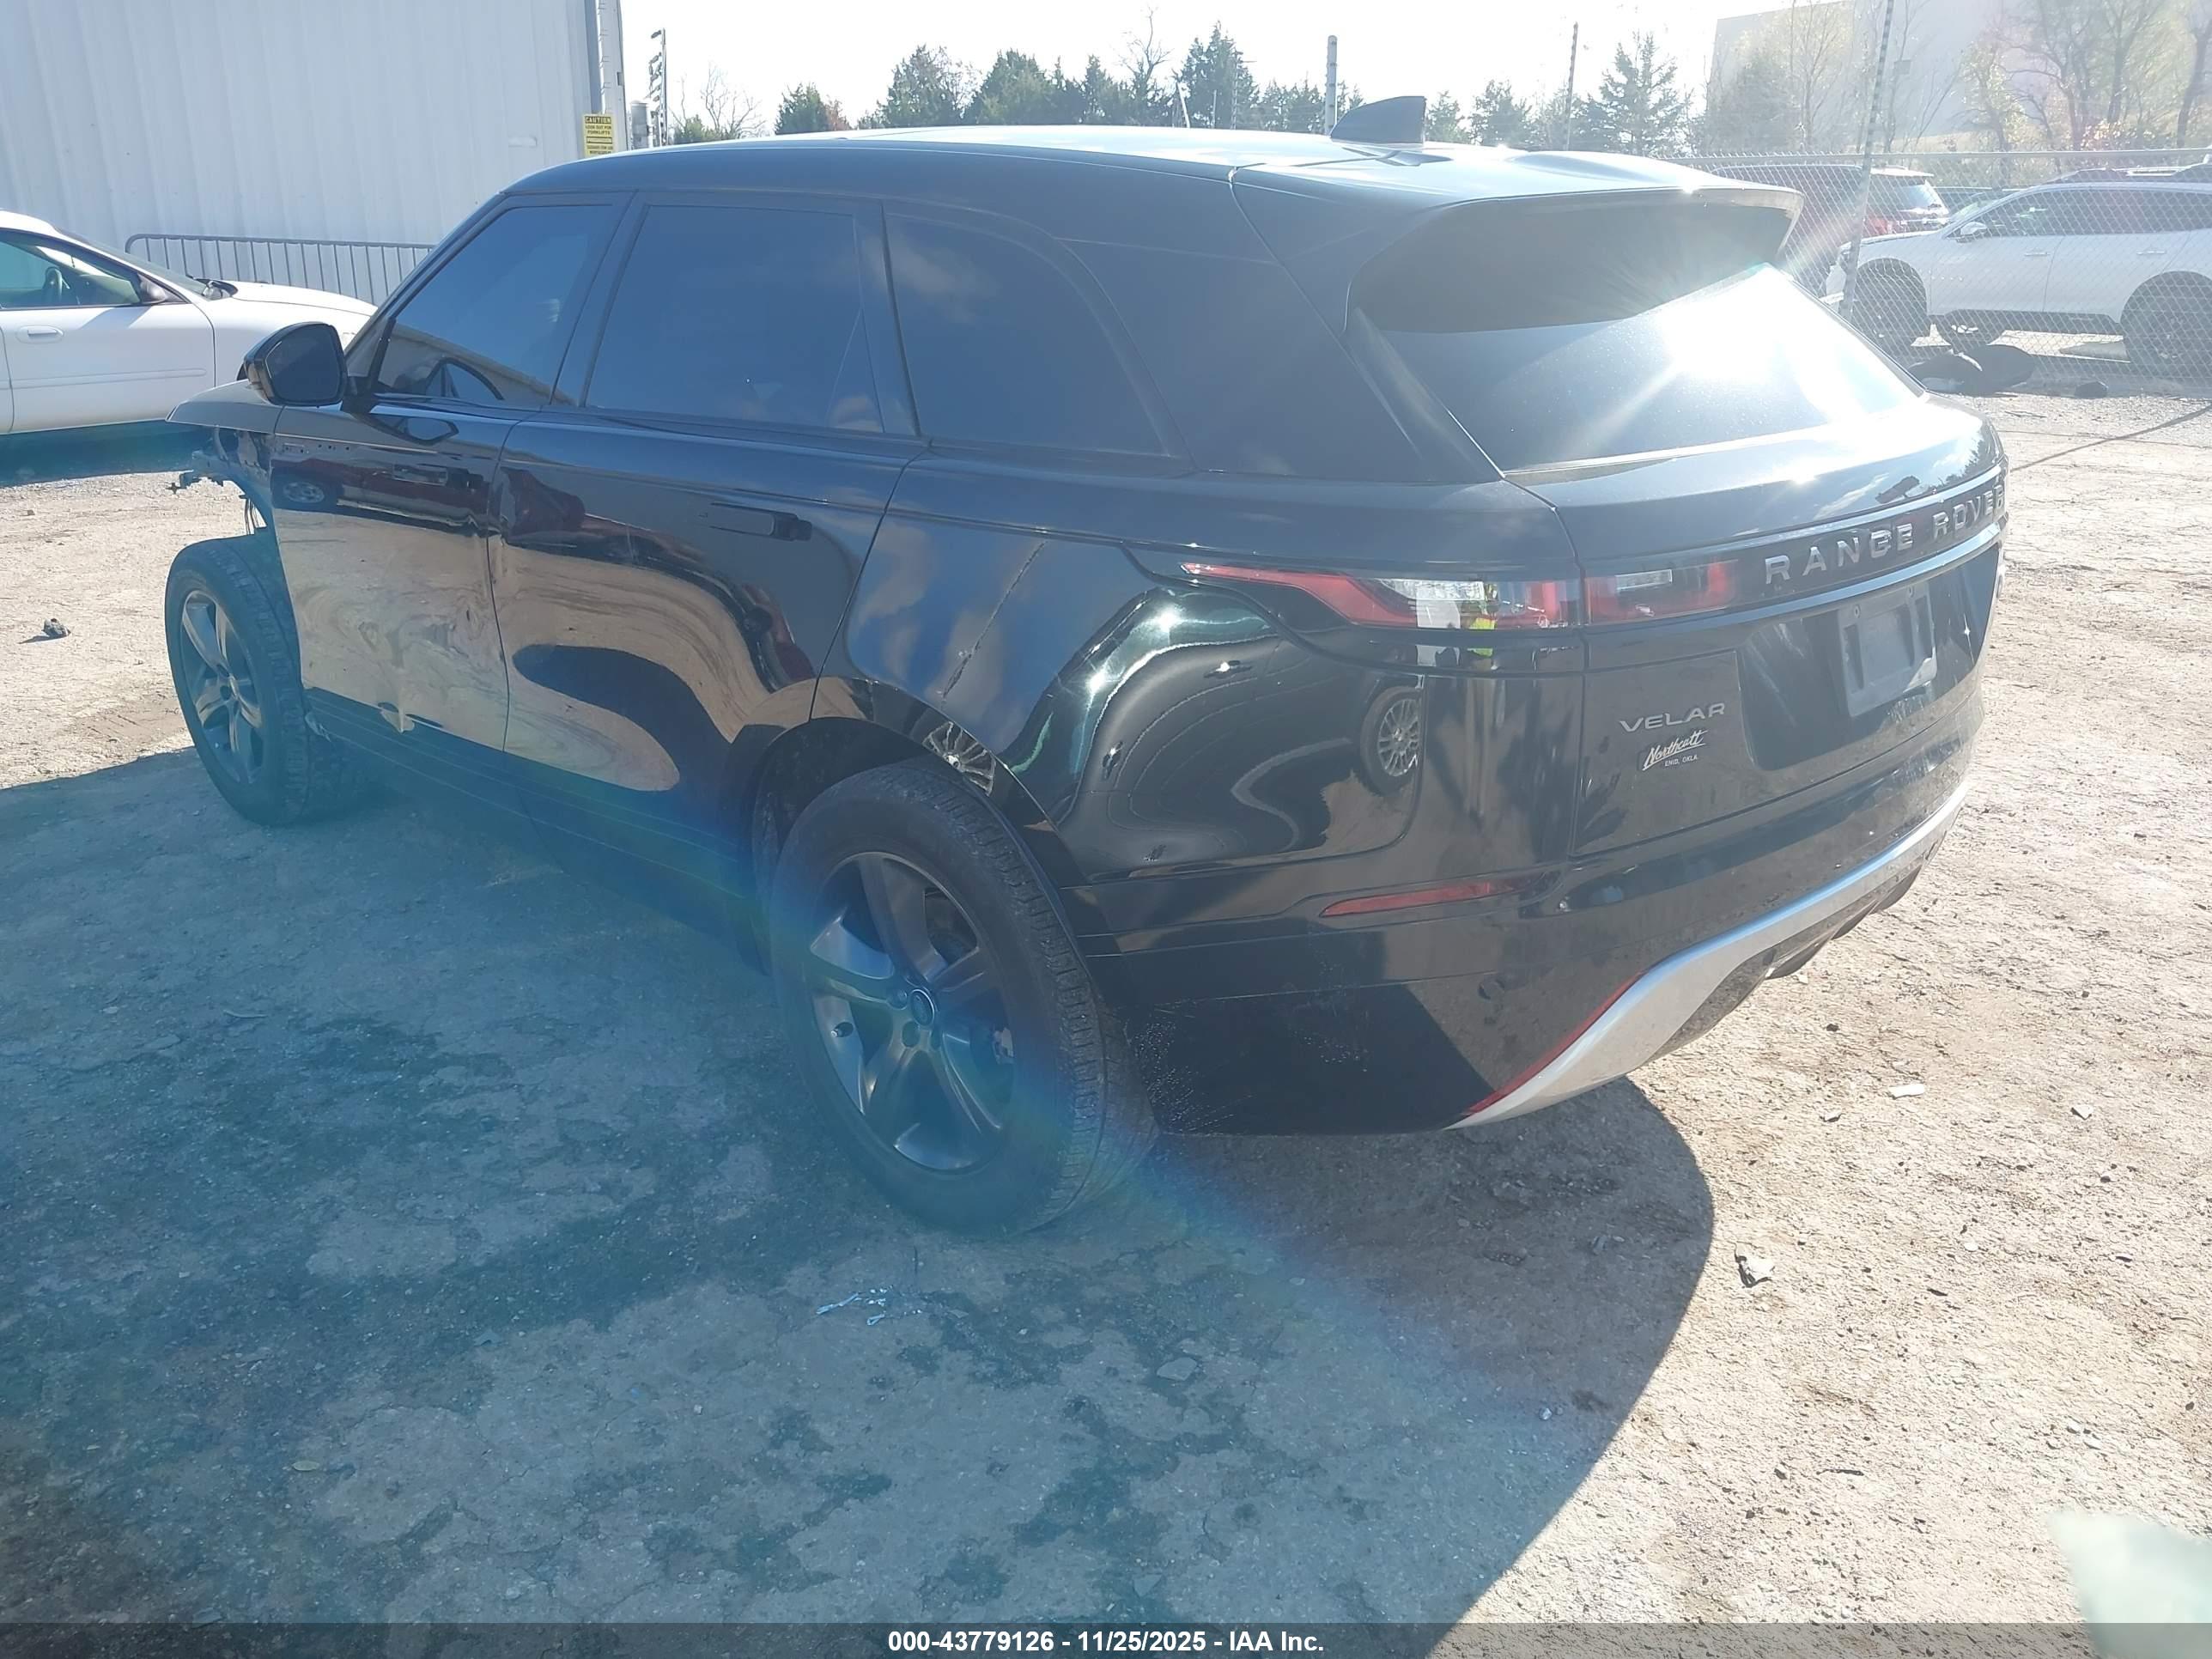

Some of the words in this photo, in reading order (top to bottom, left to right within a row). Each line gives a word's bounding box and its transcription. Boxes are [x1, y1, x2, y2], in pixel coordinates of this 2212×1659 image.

[1765, 521, 1914, 585] RANGE
[1932, 484, 2005, 541] ROVER
[1619, 702, 1726, 732] VELAR
